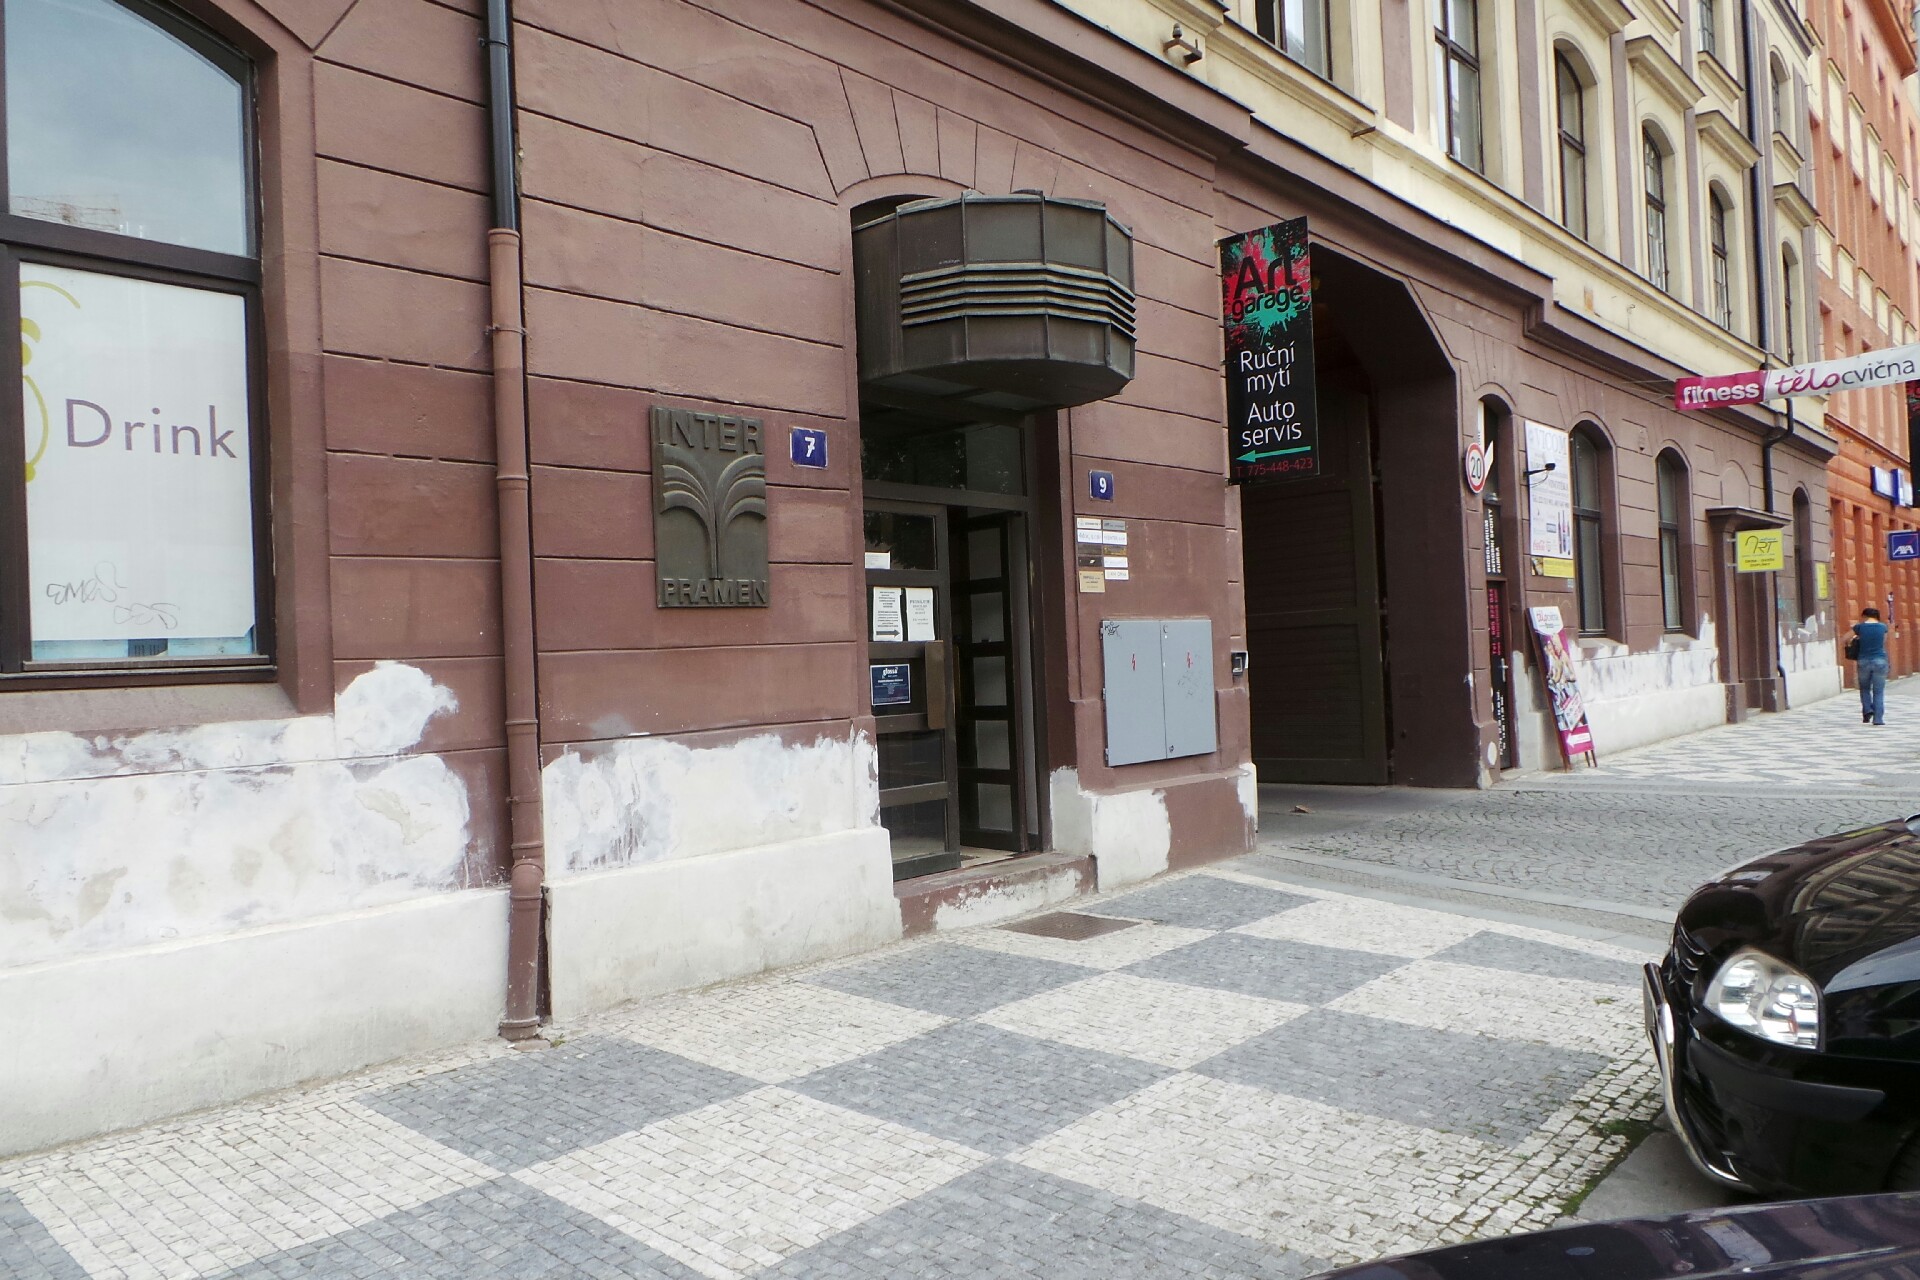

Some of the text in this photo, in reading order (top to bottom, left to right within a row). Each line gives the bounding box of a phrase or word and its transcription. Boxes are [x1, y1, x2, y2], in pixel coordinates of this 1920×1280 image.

[1233, 250, 1298, 300] Art
[1231, 283, 1304, 323] garage
[1240, 340, 1295, 373] Ruční
[1246, 363, 1291, 395] mytí
[1683, 382, 1760, 405] fitness
[1247, 400, 1295, 425] Auto
[65, 398, 238, 459] Drink
[657, 406, 764, 455] INTER
[1241, 418, 1302, 448] servis
[804, 436, 816, 458] 7
[1247, 457, 1314, 477] 775-448-423
[1470, 456, 1482, 480] 20
[1099, 477, 1107, 494] 9
[1892, 545, 1915, 557] AXA
[661, 577, 768, 605] PRAMEN
